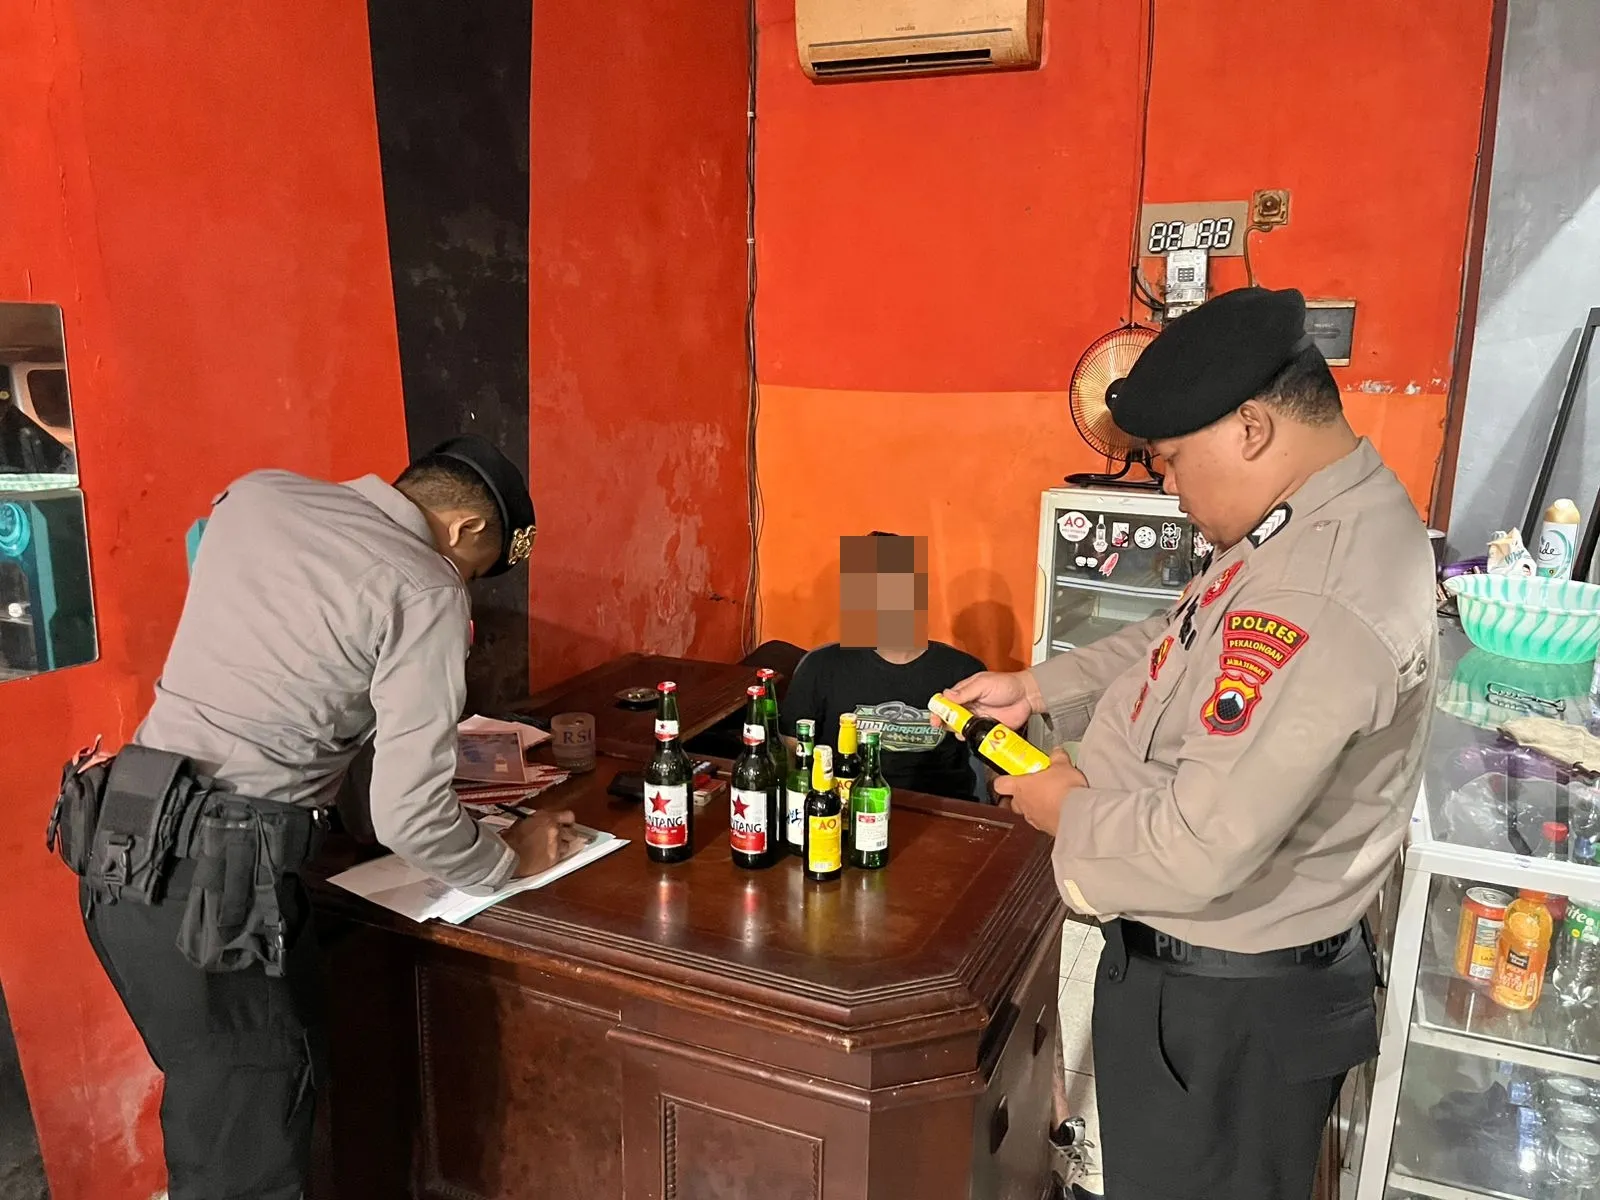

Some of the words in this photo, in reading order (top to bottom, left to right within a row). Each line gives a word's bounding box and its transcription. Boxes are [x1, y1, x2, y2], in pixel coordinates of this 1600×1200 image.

[1064, 516, 1085, 528] AO
[1231, 616, 1297, 644] POLRES
[1229, 639, 1283, 661] PEKALONGAN
[819, 819, 837, 830] AO
